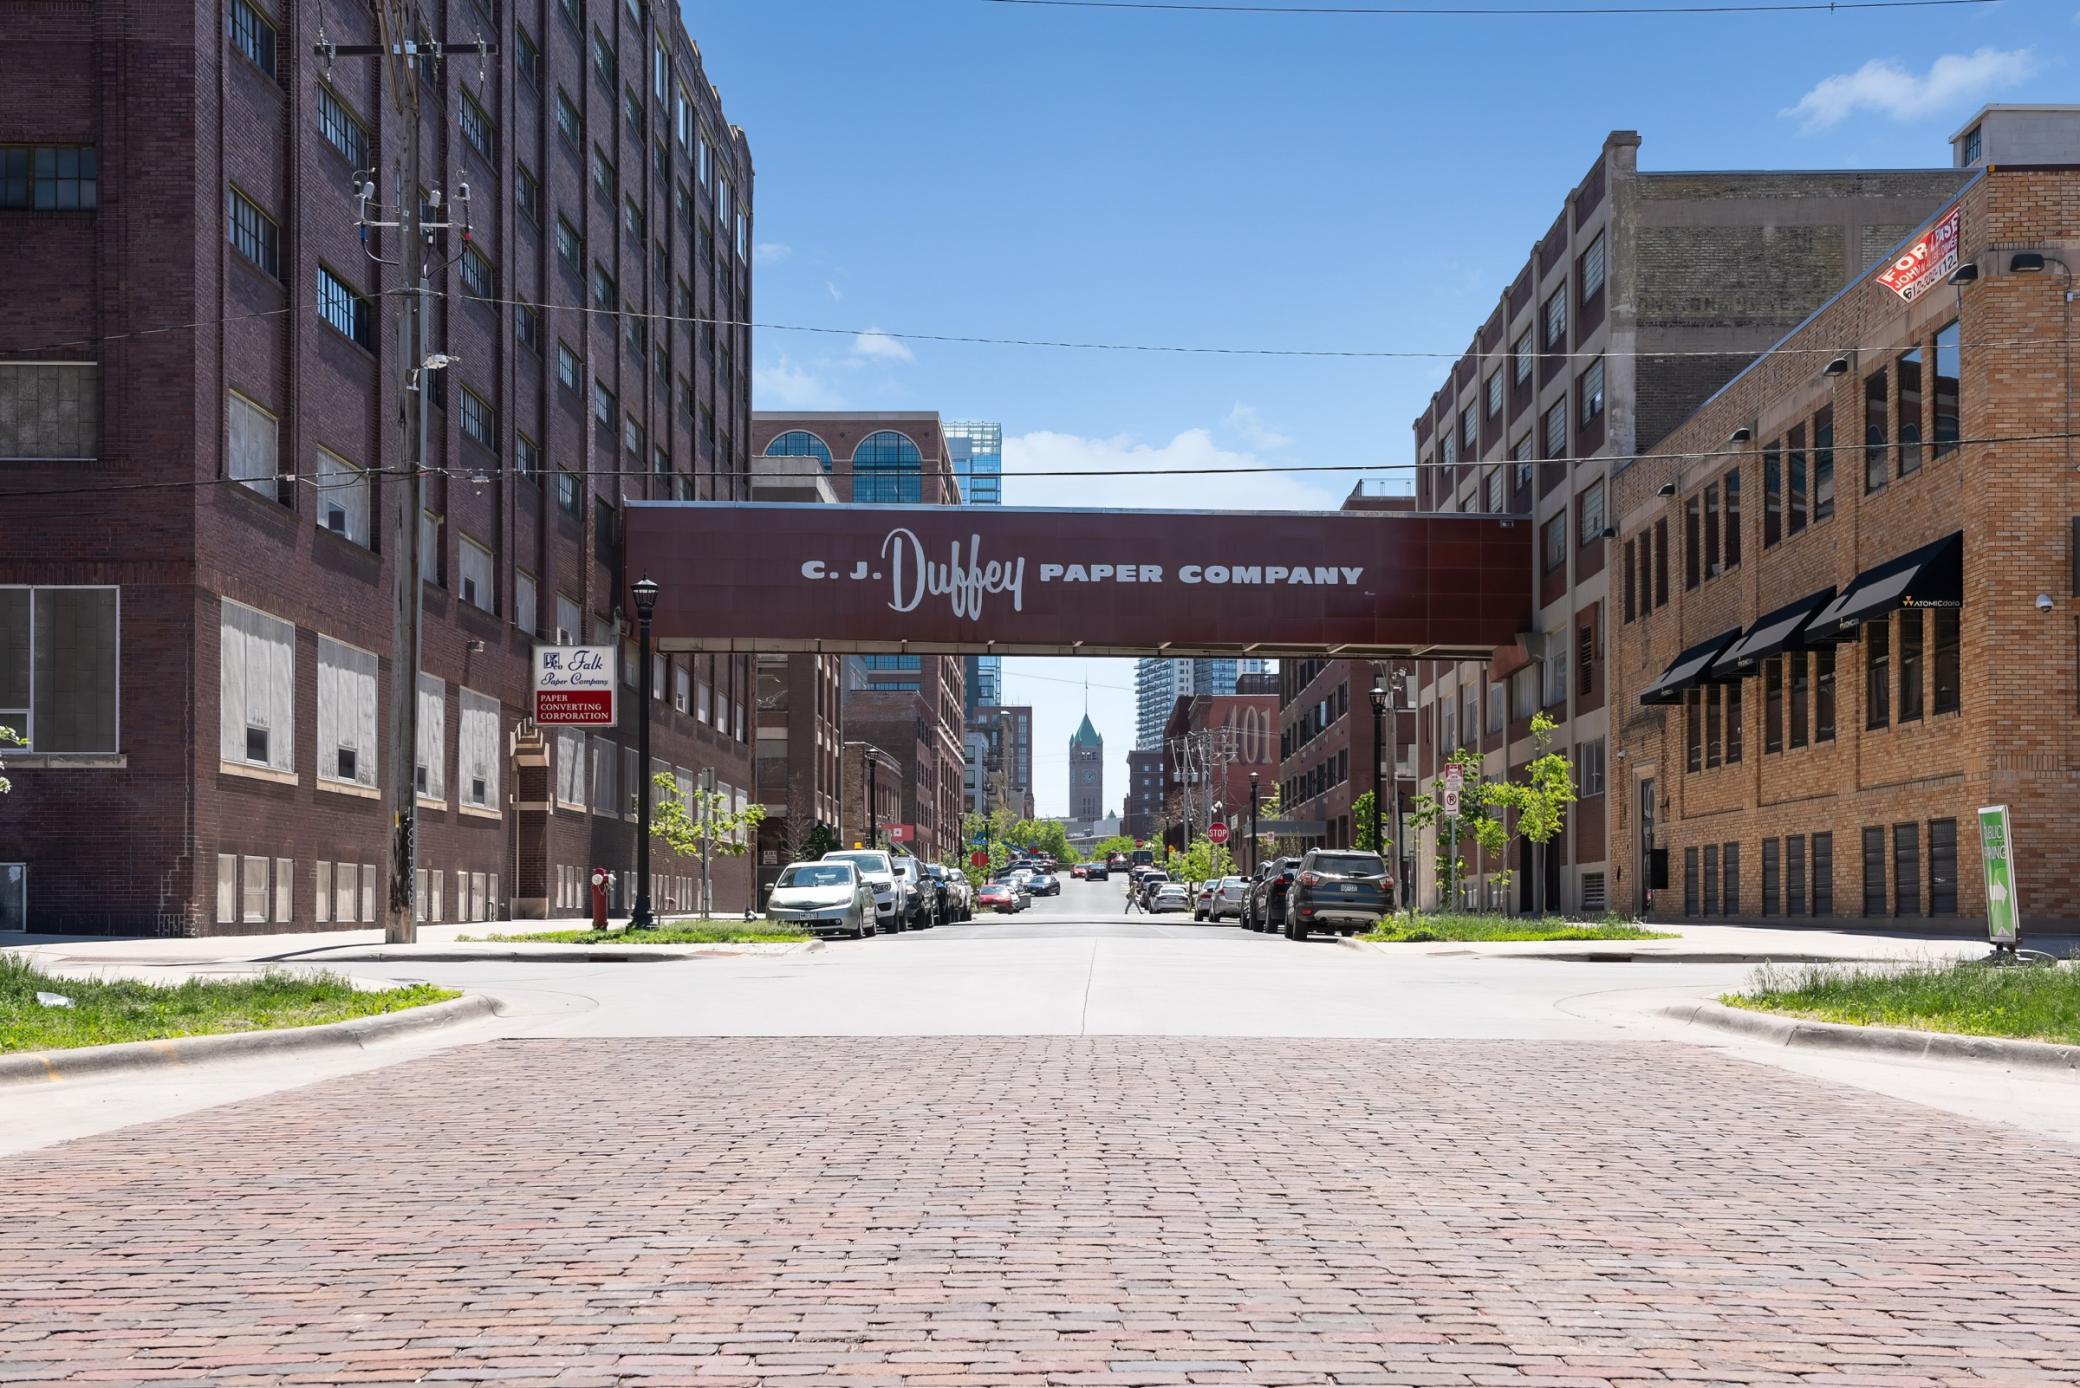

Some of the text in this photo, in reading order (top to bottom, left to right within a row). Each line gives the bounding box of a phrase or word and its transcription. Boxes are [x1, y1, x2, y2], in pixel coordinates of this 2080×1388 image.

[1881, 242, 1928, 282] FOR
[881, 527, 1025, 621] Duffey
[1040, 563, 1163, 583] PAPER
[1178, 564, 1364, 585] COMPANY
[568, 650, 603, 671] Falk
[541, 672, 608, 686] Paper Company
[541, 694, 568, 702] PAPER
[541, 703, 602, 711] CONVERTING
[541, 712, 609, 720] CORPORATION
[1209, 829, 1227, 838] STOP
